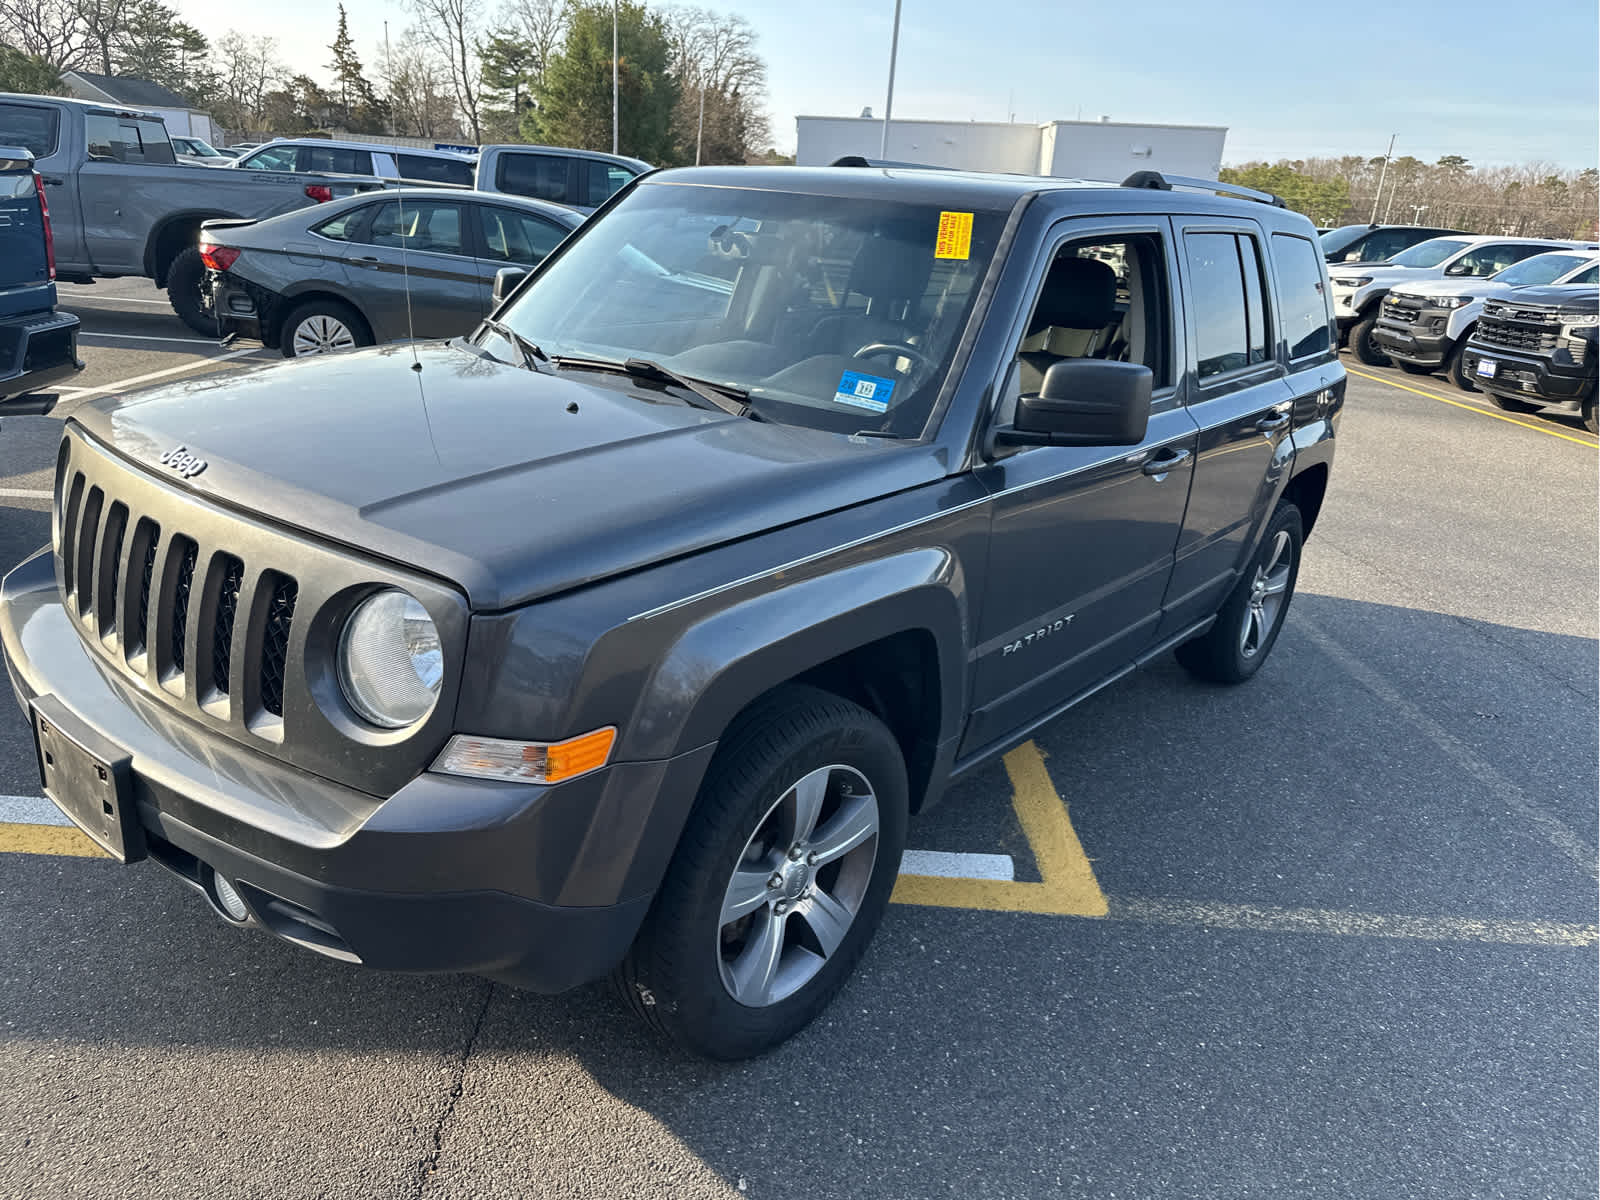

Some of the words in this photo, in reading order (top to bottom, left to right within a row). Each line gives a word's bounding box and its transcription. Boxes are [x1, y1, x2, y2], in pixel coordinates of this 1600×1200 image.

[938, 213, 950, 239] VEHICLE
[937, 241, 946, 255] THIS
[160, 445, 208, 479] Jeep
[1002, 614, 1075, 657] PATRIOT
